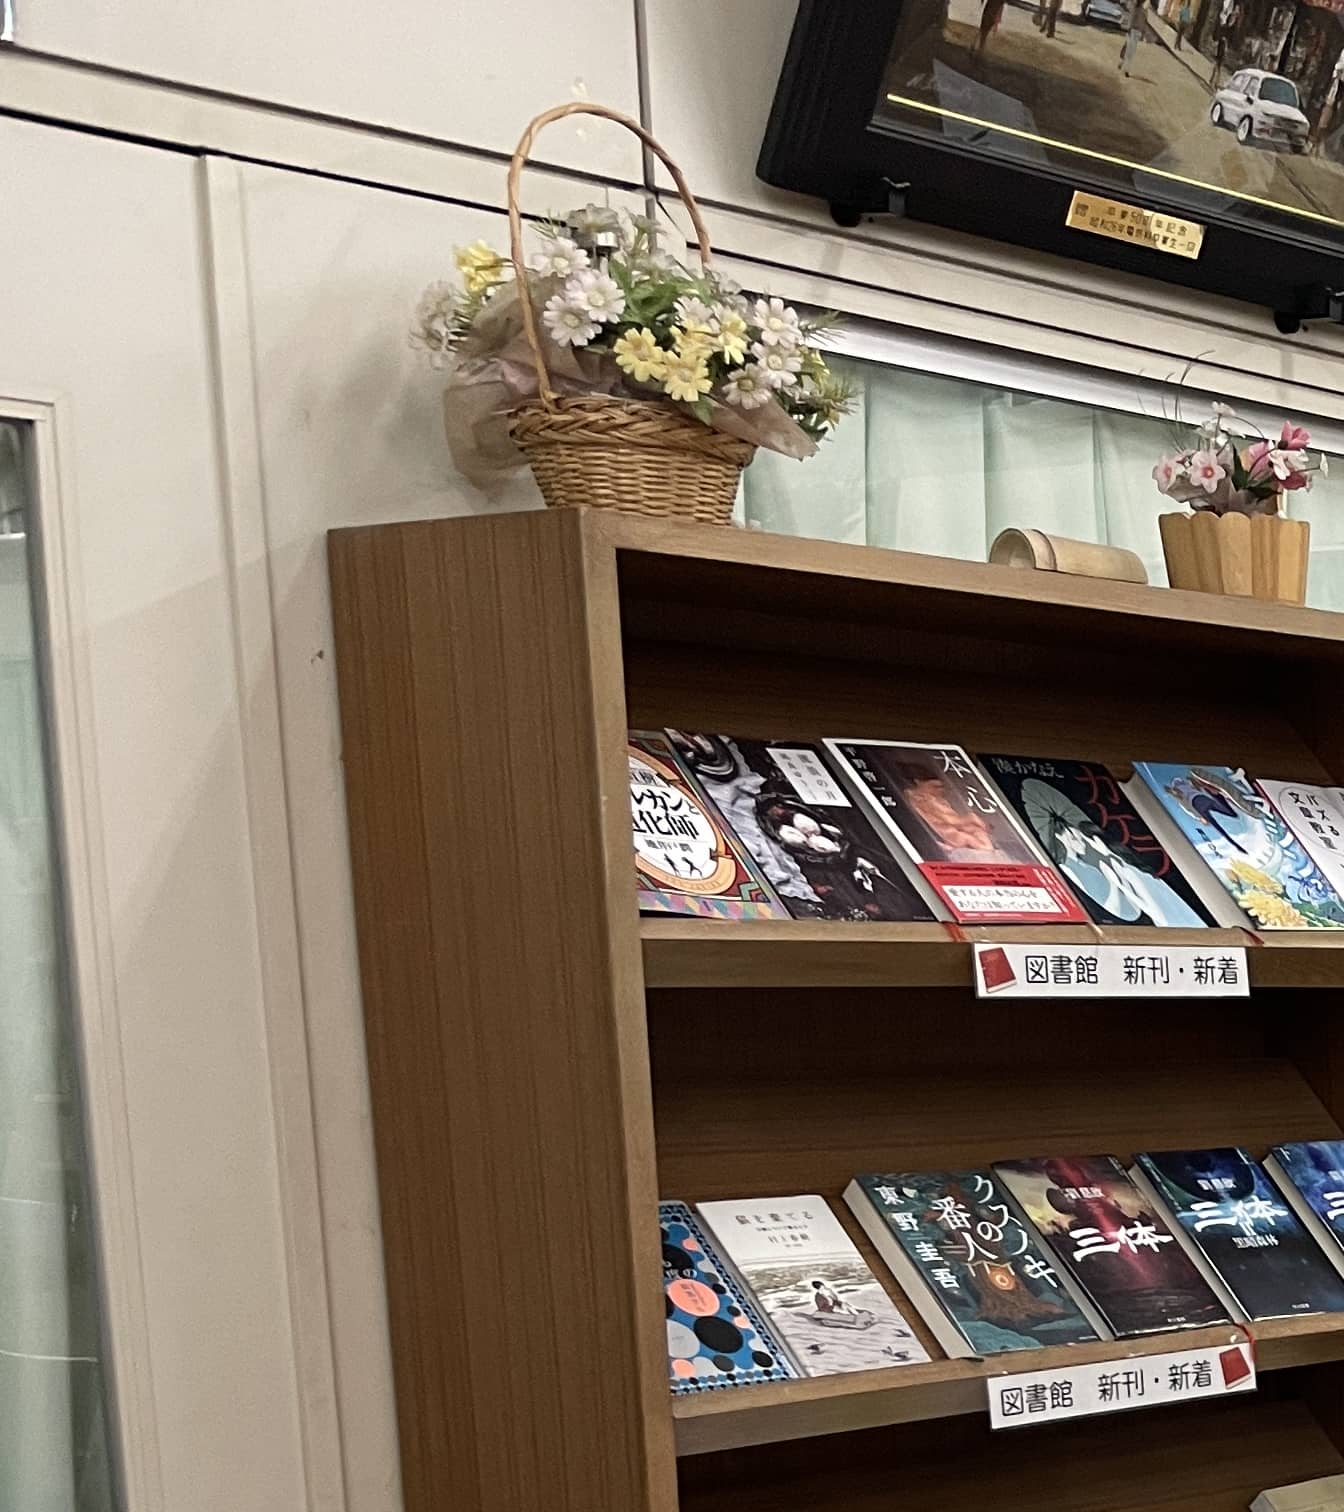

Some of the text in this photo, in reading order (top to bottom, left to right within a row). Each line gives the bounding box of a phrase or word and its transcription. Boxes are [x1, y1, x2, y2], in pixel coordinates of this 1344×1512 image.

[932, 749, 998, 815] 本心
[1073, 763, 1172, 878] カケラ
[1024, 955, 1240, 985] 図書館 新刊・新着
[874, 1184, 961, 1290] 東野圭吾
[1069, 1220, 1174, 1264] 三体
[1190, 1195, 1289, 1234] 三体
[1000, 1360, 1214, 1417] 図書館 新刊・新着
